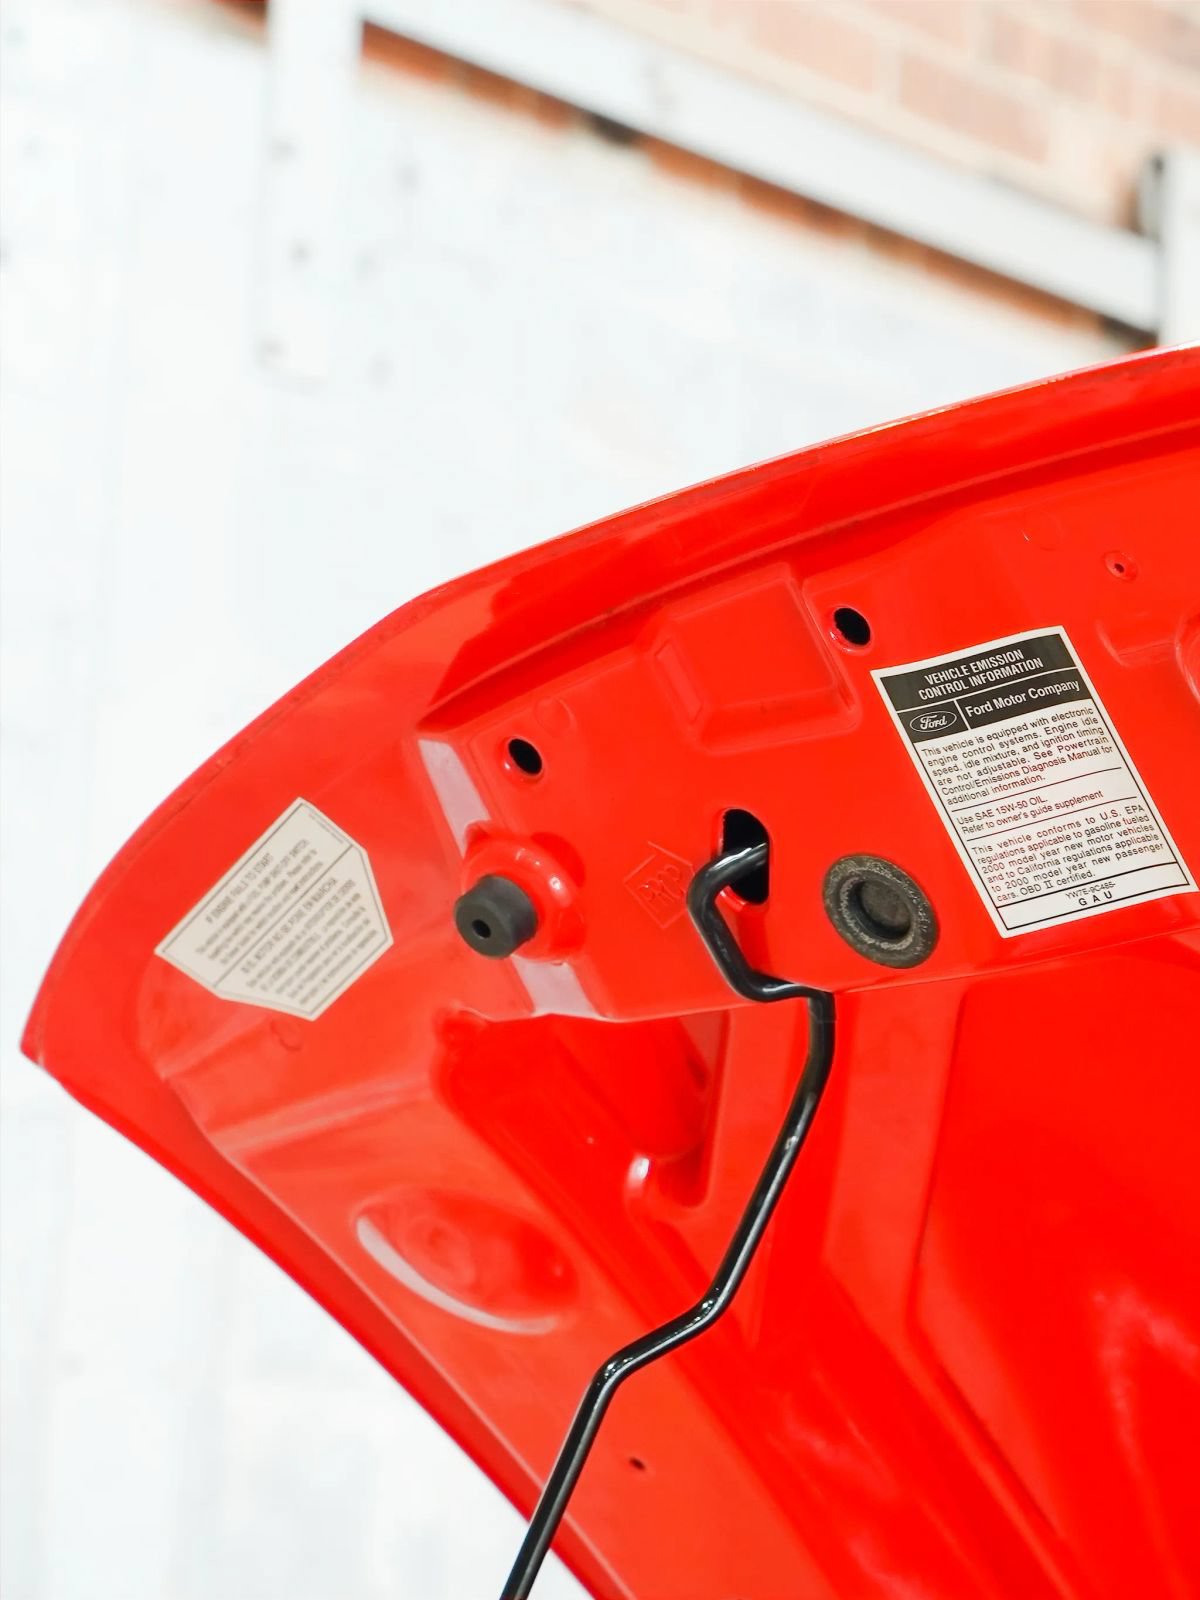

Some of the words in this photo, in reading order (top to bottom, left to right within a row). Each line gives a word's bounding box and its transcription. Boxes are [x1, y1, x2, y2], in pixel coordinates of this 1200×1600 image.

[918, 680, 969, 700] CONTROL
[968, 658, 1043, 687] INFORMATION
[924, 665, 970, 685] VEHICLE
[969, 649, 1024, 673] EMISSION
[965, 701, 994, 717] Ford
[992, 693, 1026, 709] Motor
[1028, 681, 1080, 699] Company
[919, 714, 948, 730] Ford
[921, 747, 942, 757] This
[942, 739, 974, 753] vehicle
[974, 736, 985, 744] is
[986, 722, 1029, 741] equipped
[1029, 717, 1050, 728] with
[1051, 707, 1094, 723] electronic
[927, 754, 959, 767] engine
[961, 742, 996, 759] control
[998, 732, 1042, 749] systems.
[1043, 721, 1079, 735] Engine
[1080, 717, 1099, 726] idle
[932, 763, 963, 777] speed,
[963, 759, 981, 769] idle
[982, 749, 1020, 764] mixture,
[1021, 741, 1040, 753] and
[1040, 732, 1076, 749] ignition
[1076, 727, 1105, 738] timing
[937, 777, 953, 786] are
[956, 771, 973, 782] not
[976, 757, 1030, 777] adjustable.
[1033, 749, 1053, 760] See
[1056, 736, 1109, 754] Powertrain
[1021, 756, 1067, 775] Diagnosis
[1066, 747, 1101, 762] Manual
[1100, 745, 1113, 754] for
[947, 788, 990, 806] additional
[991, 774, 1046, 793] information.
[956, 816, 974, 825] Use
[974, 808, 995, 821] SAE
[995, 800, 1028, 815] 15W-50
[1028, 795, 1048, 806] OIL.
[961, 823, 984, 834] Refer
[985, 821, 995, 829] to
[996, 811, 1029, 826] owner's
[1029, 805, 1053, 818] guide
[1054, 790, 1104, 810] supplement
[971, 845, 994, 855] This
[996, 834, 1032, 849] vehicle
[1036, 821, 1082, 838] conforms
[1084, 817, 1096, 825] to
[1099, 809, 1122, 821] U.S.
[1124, 804, 1145, 815] EPA
[977, 847, 1026, 865] regulations
[1027, 834, 1072, 852] applicable
[1072, 831, 1083, 839] to
[1084, 820, 1122, 838] gasoline
[1122, 814, 1150, 825] fueled
[981, 862, 1005, 874] 2000
[1008, 853, 1038, 867] model
[1039, 847, 1060, 861] year
[1064, 841, 1083, 852] new
[1086, 833, 1114, 846] motor
[1116, 824, 1155, 837] vehicles
[987, 873, 1005, 884] and
[1005, 871, 1016, 879] to
[1017, 858, 1061, 875] California
[1062, 844, 1113, 863] regulations
[1115, 833, 1159, 849] applicable
[991, 885, 1002, 893] to
[1004, 876, 1029, 890] 2000
[1033, 867, 1063, 881] model
[1065, 861, 1087, 875] year
[1091, 855, 1111, 866] new
[1115, 843, 1163, 861] passenger
[996, 892, 1019, 902] cars.
[1019, 883, 1042, 896] OBD
[1056, 869, 1096, 886] certified.
[1078, 897, 1088, 906] G
[1092, 894, 1101, 903] A
[1103, 890, 1113, 900] U
